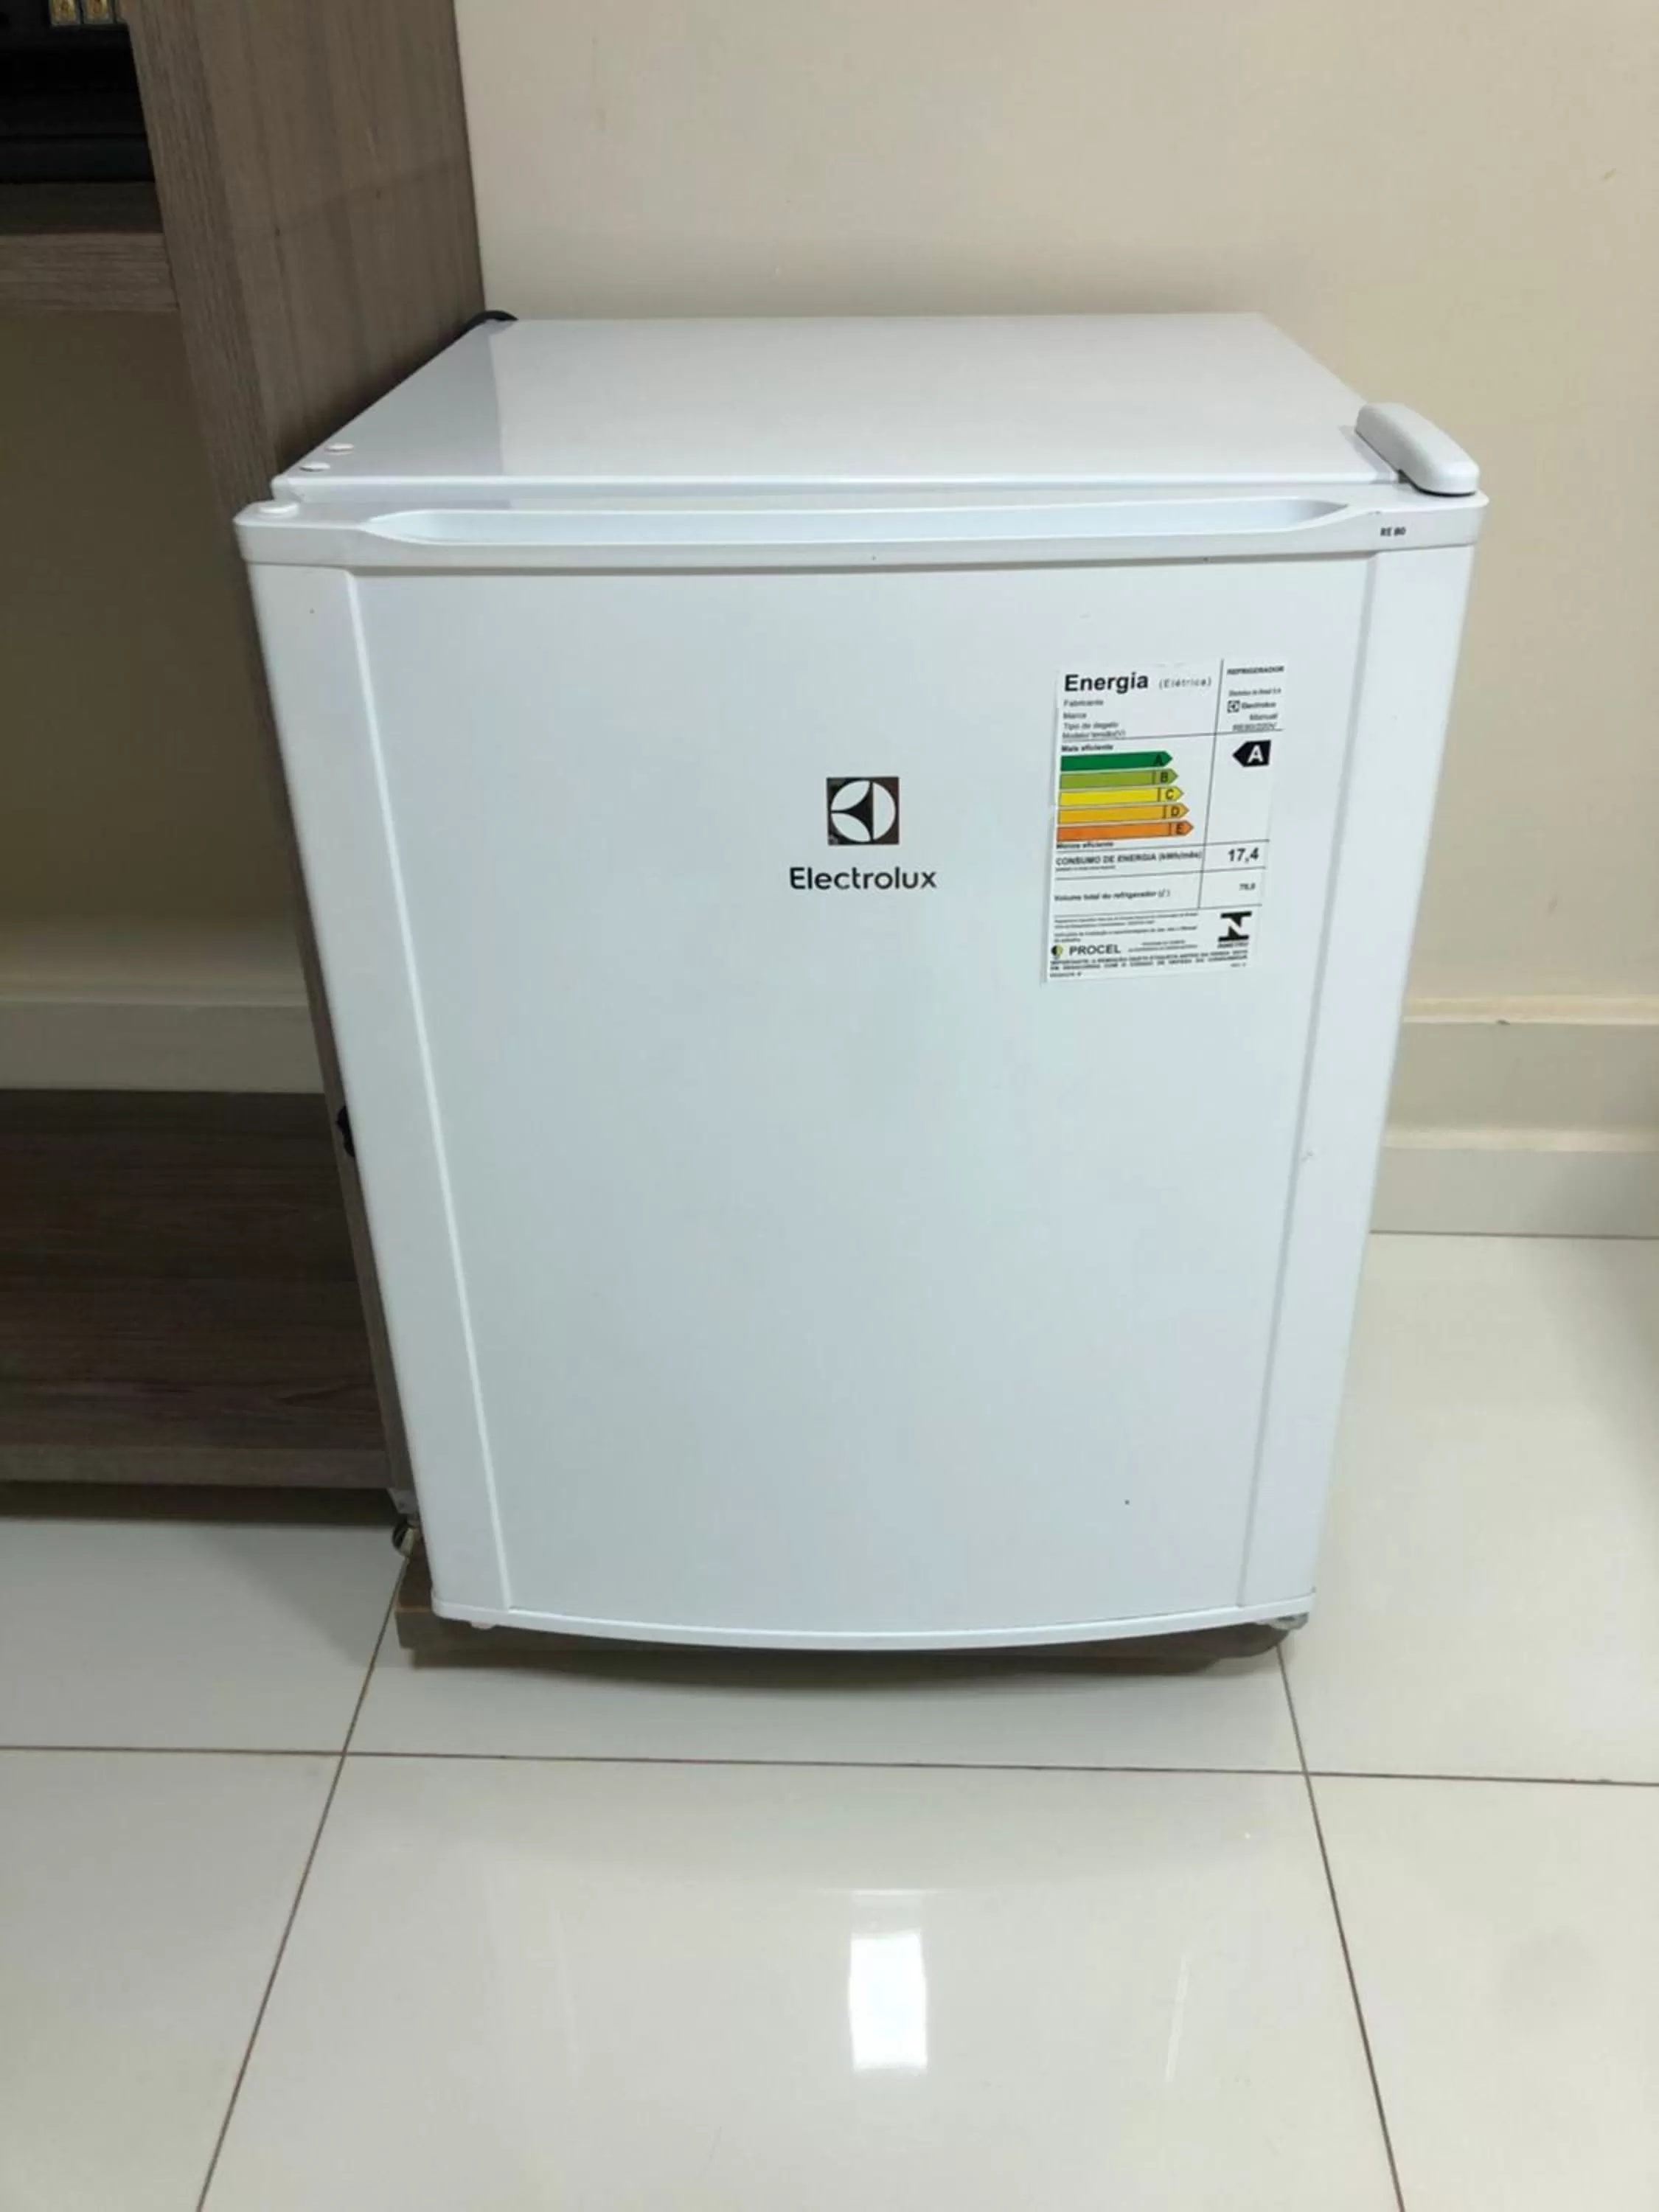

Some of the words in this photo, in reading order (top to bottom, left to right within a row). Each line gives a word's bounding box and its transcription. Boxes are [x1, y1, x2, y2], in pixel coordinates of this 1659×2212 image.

[1064, 672, 1149, 695] Energia
[1152, 754, 1164, 766] A
[1247, 745, 1264, 764] A
[1160, 772, 1169, 784] B
[1165, 789, 1175, 800] C
[1170, 806, 1180, 817] D
[1175, 822, 1185, 835] E
[1055, 855, 1101, 866] CONSUMO
[1102, 855, 1116, 863] DE
[1117, 852, 1157, 863] ENERGIA
[1228, 847, 1259, 863] 17,4
[789, 866, 937, 890] Electrolux
[1069, 944, 1121, 956] PROCEL
